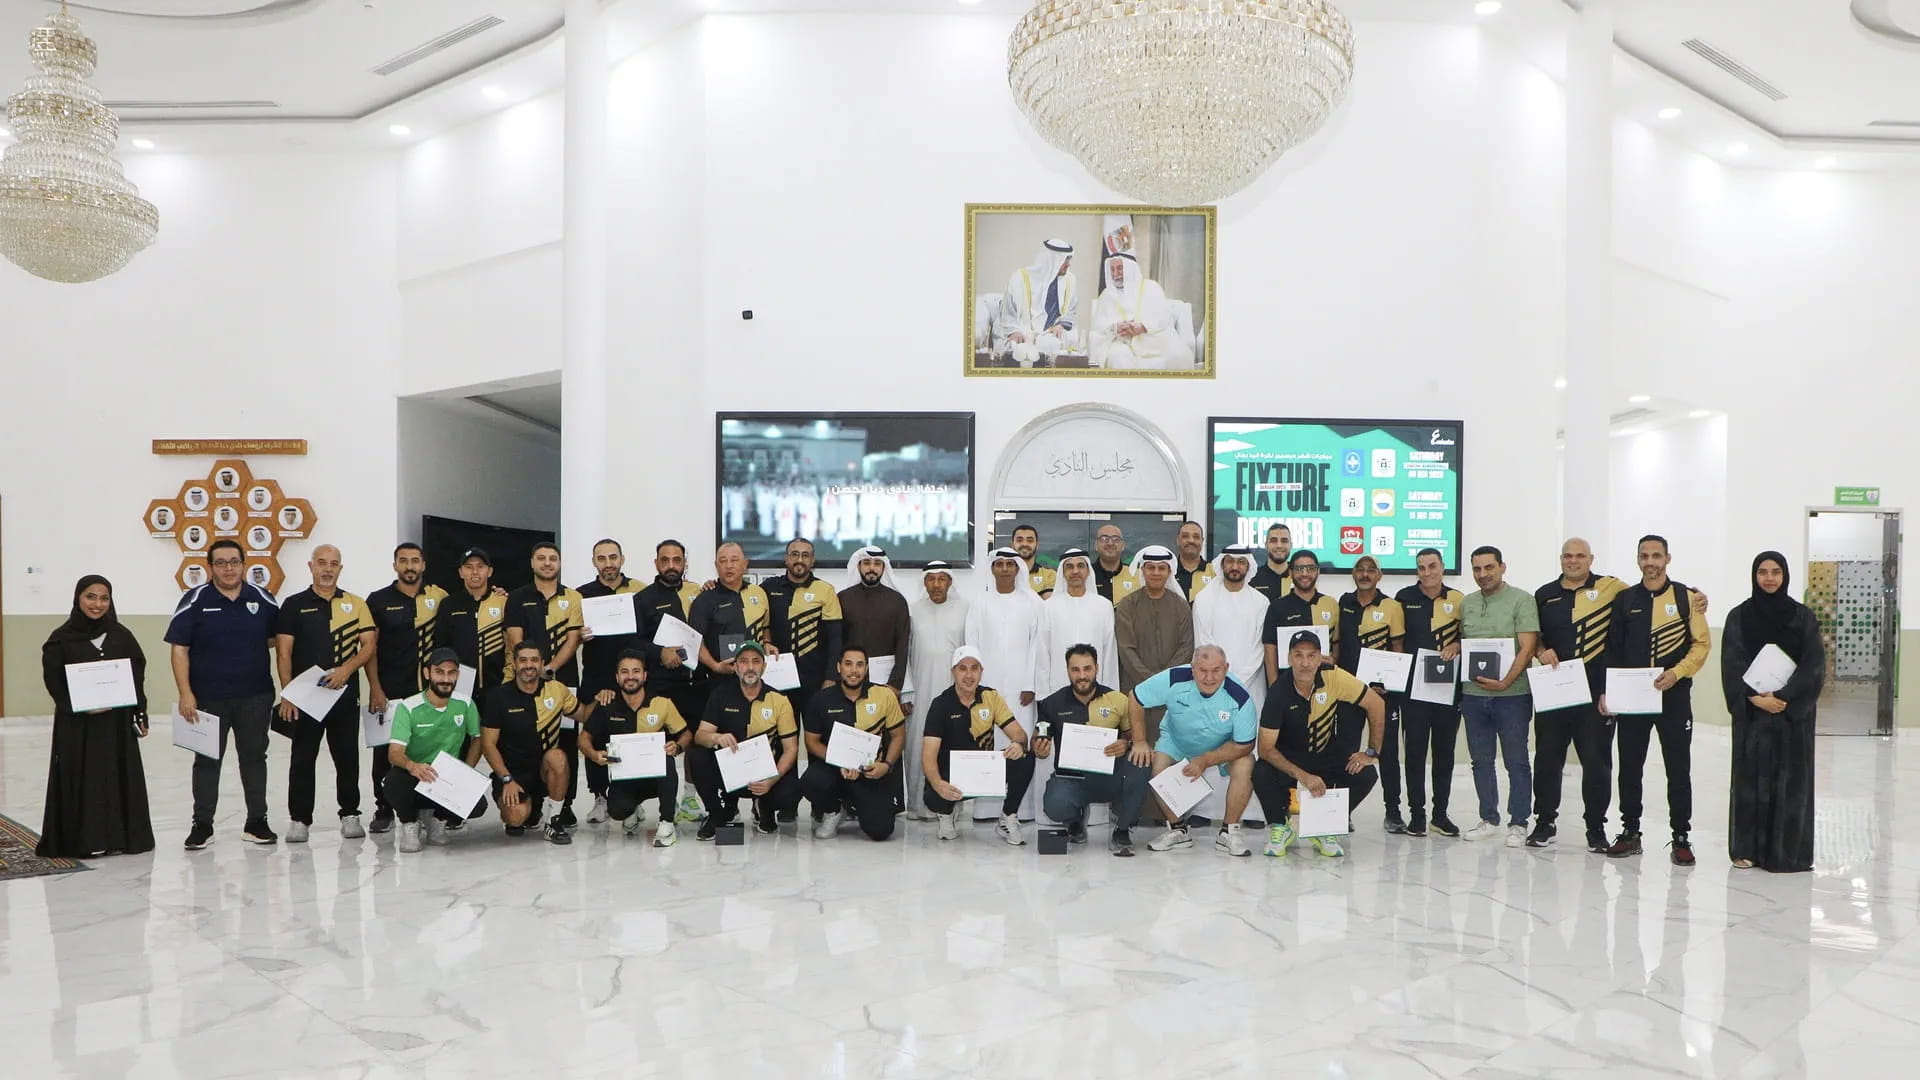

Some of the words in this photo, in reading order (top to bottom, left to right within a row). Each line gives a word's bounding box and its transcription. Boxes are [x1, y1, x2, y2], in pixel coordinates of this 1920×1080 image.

[1045, 450, 1088, 478] النادي
[1090, 451, 1134, 480] مجلس
[832, 484, 868, 496] الحصن
[1236, 462, 1330, 512] FIXTURE
[1237, 517, 1323, 549] DECBER
